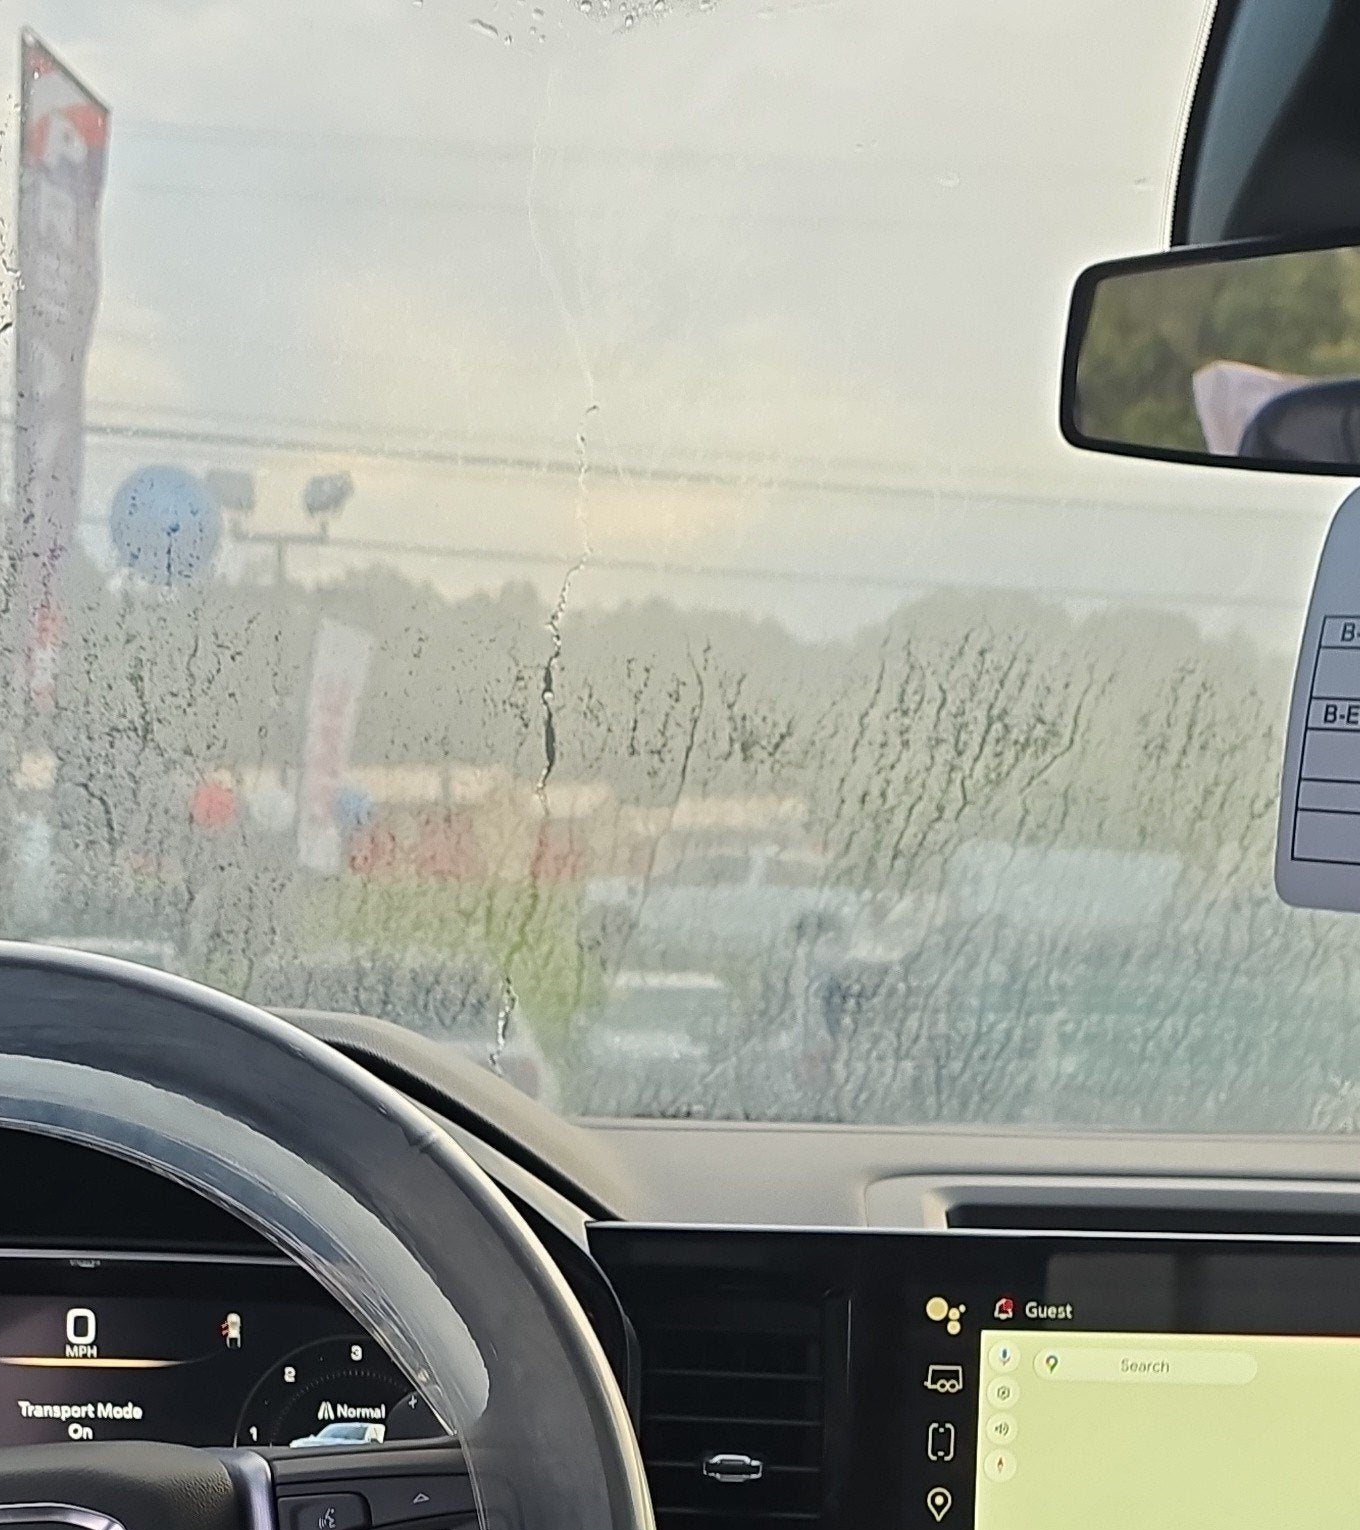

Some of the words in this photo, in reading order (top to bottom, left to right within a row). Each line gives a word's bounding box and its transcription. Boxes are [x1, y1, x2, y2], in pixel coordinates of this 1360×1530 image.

[1025, 1302, 1073, 1319] Guest
[66, 1308, 96, 1344] 0
[65, 1345, 98, 1358] MPH
[350, 1345, 363, 1361] 3
[1120, 1358, 1170, 1374] Search
[284, 1367, 296, 1382] 2
[18, 1401, 94, 1421] Transport
[97, 1401, 143, 1420] Mode
[337, 1404, 387, 1419] Normal
[68, 1423, 94, 1440] On
[249, 1426, 258, 1442] 1
